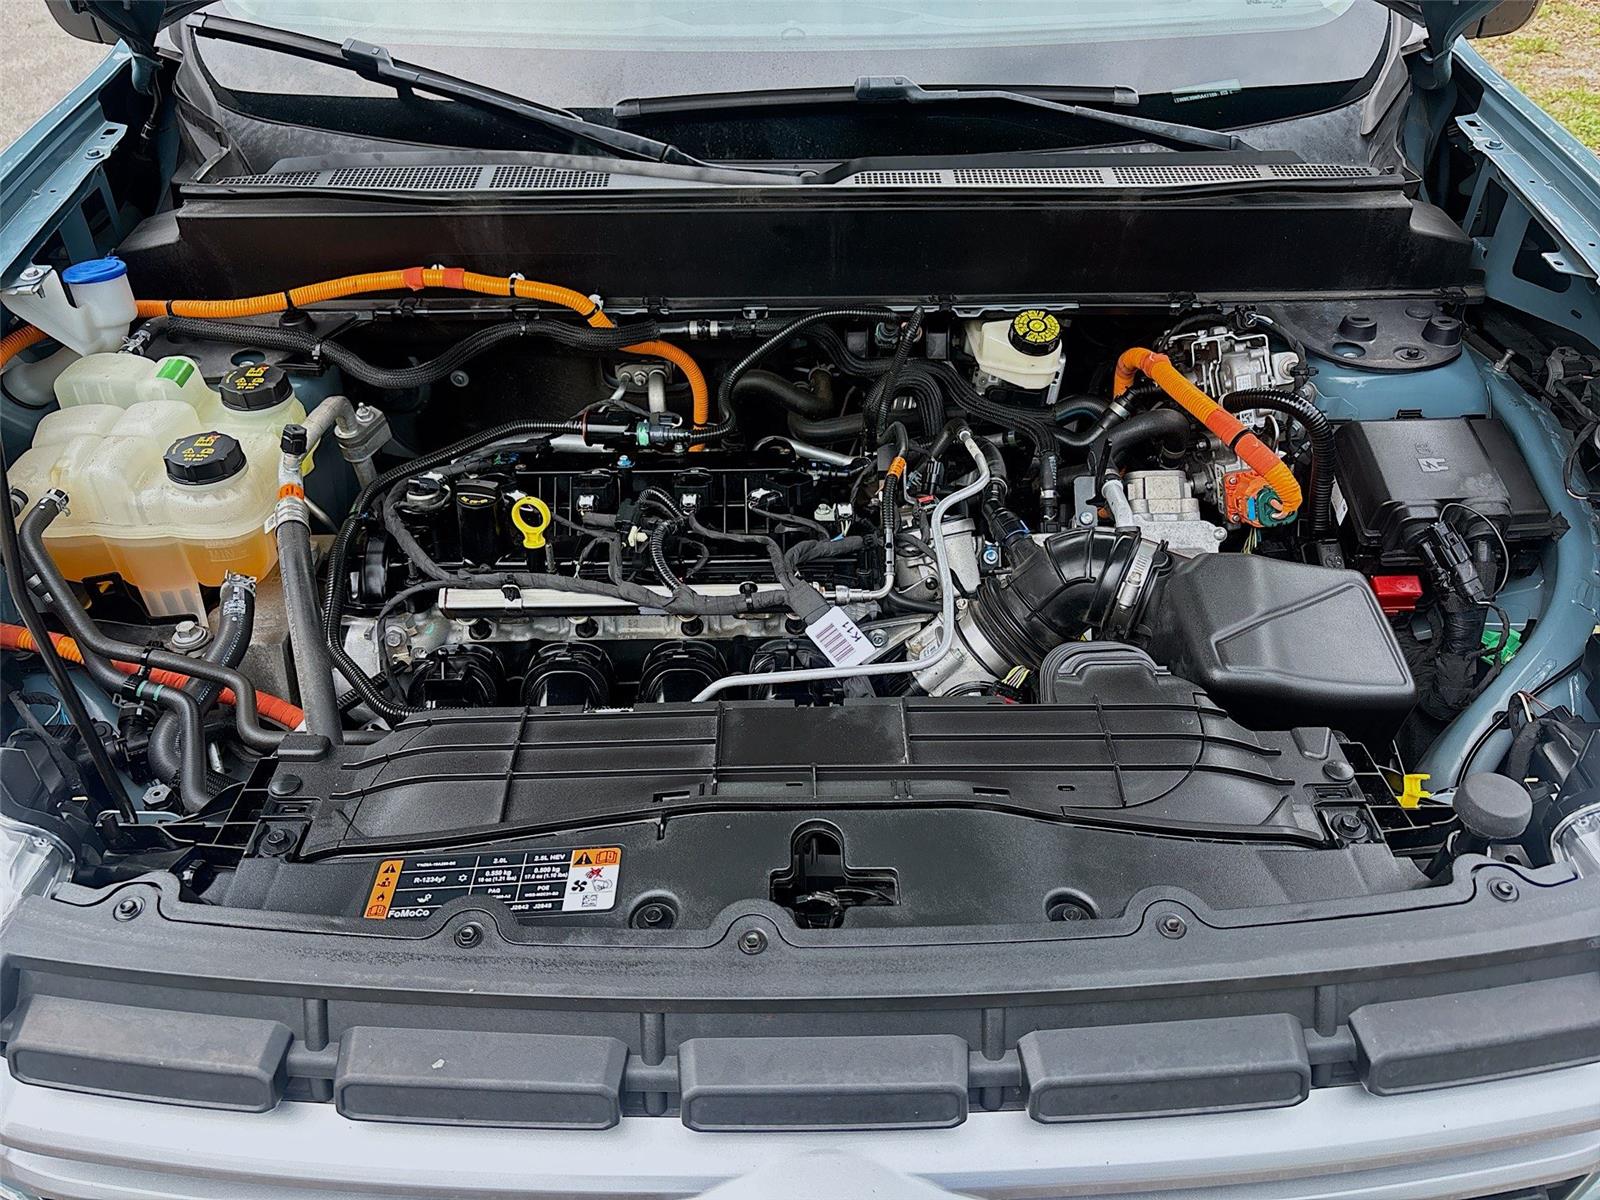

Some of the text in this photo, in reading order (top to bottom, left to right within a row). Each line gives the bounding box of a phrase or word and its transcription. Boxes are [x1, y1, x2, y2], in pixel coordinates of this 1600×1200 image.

[842, 621, 862, 642] K11
[503, 869, 512, 877] kg
[413, 875, 447, 884] R-1234yf
[388, 908, 430, 918] FoMoCo
